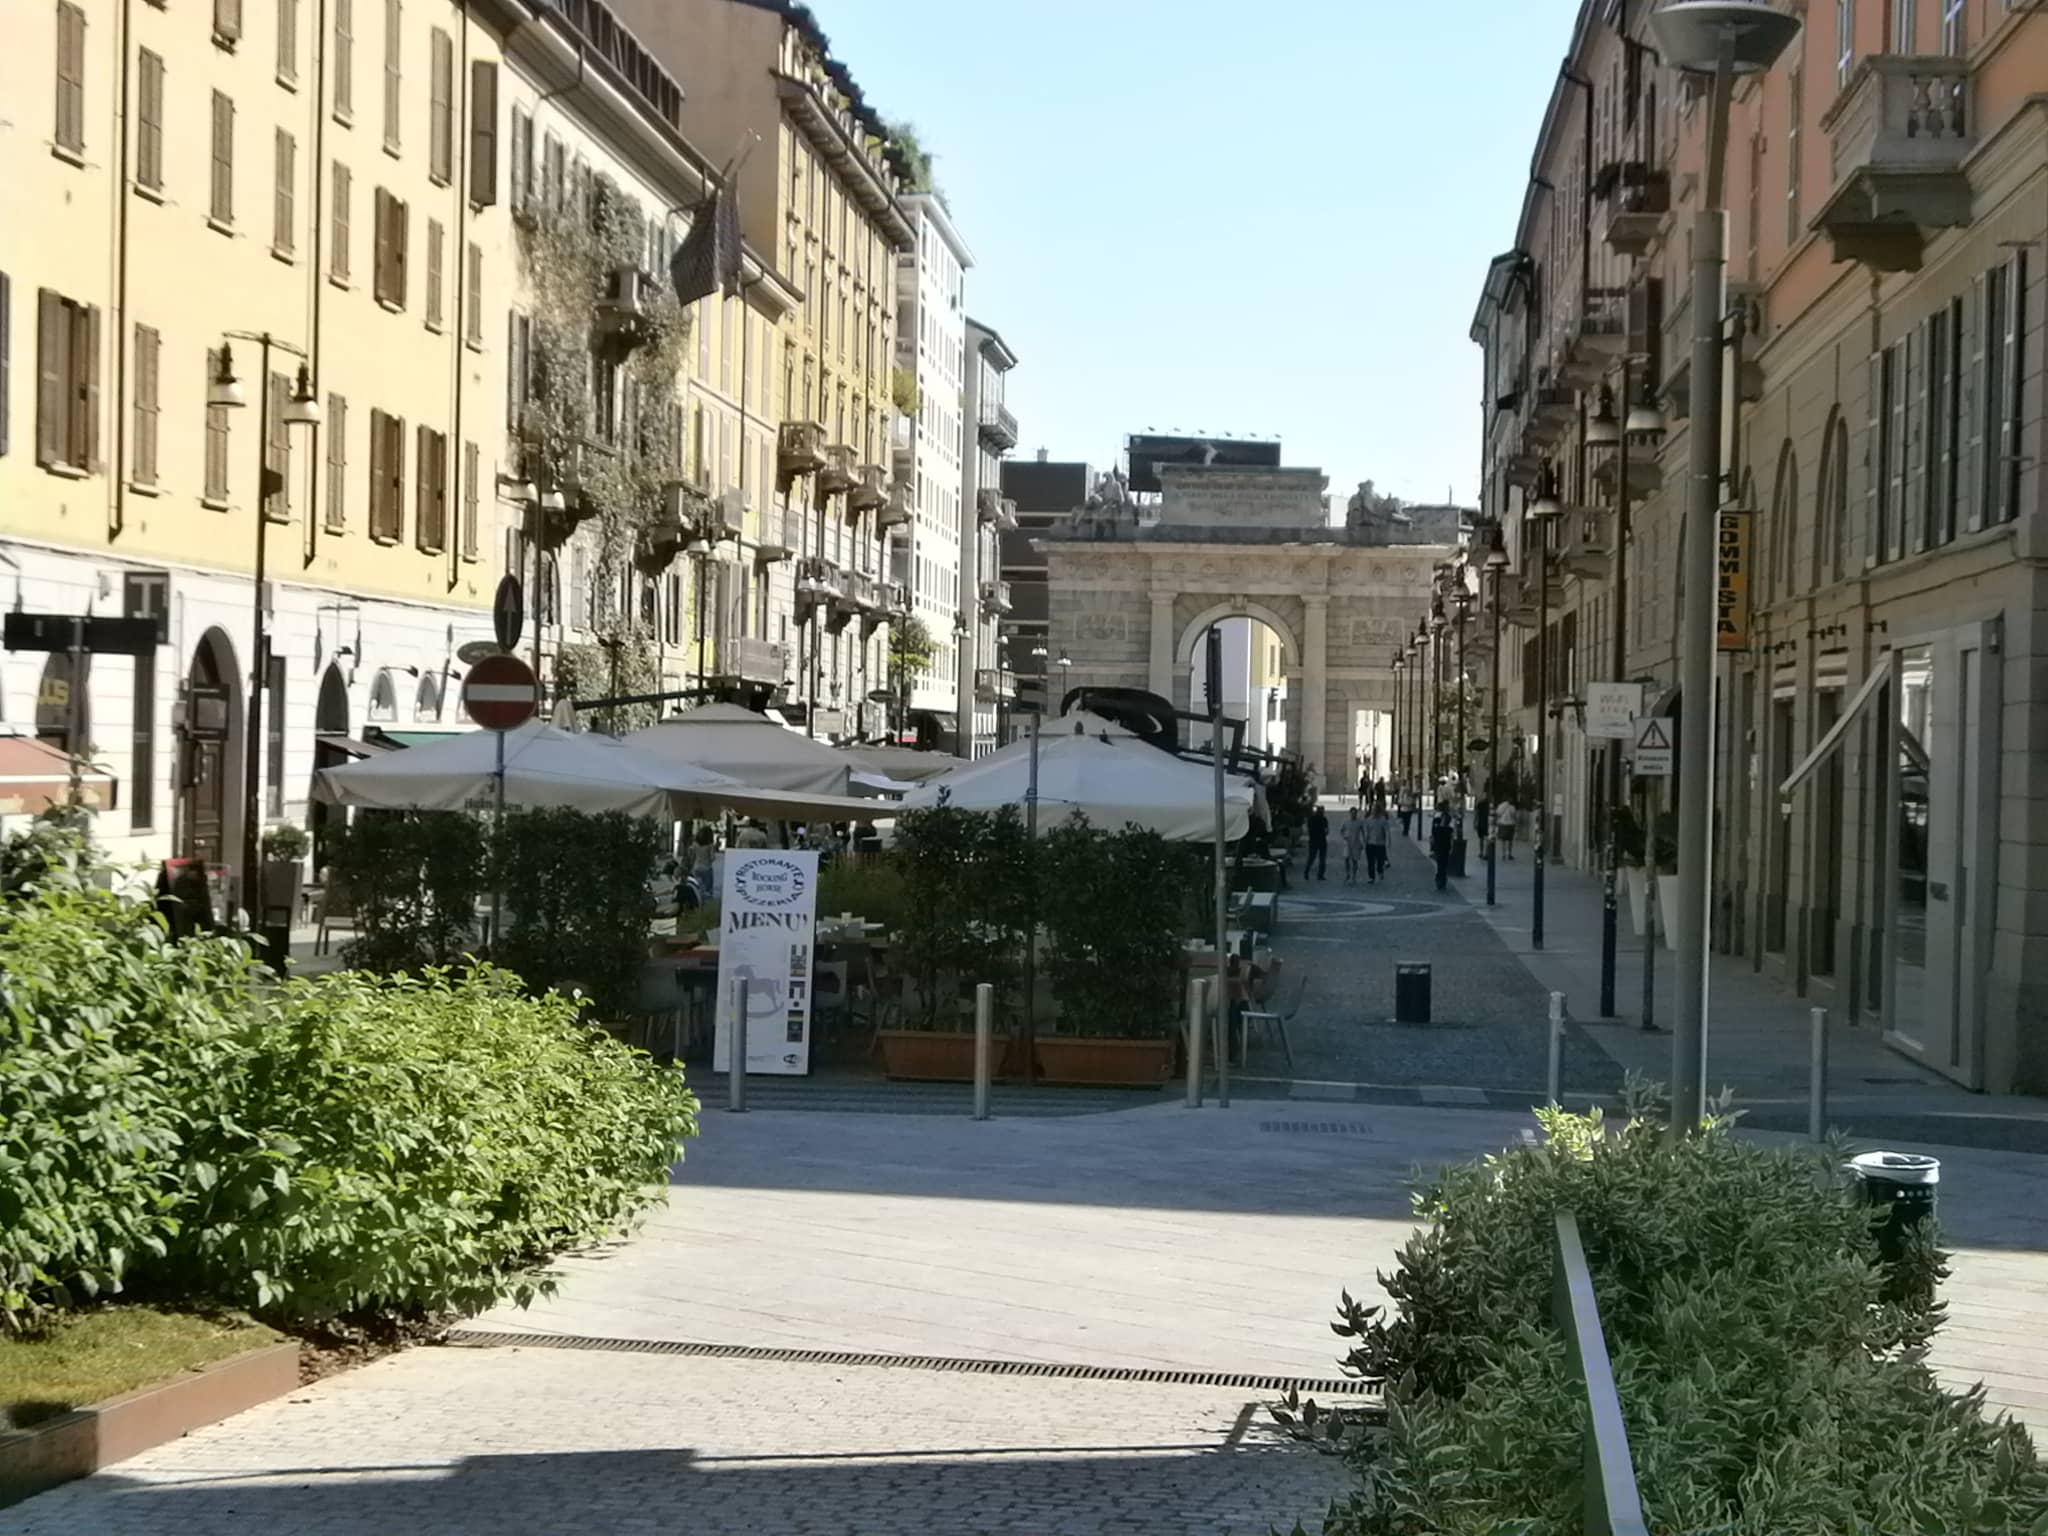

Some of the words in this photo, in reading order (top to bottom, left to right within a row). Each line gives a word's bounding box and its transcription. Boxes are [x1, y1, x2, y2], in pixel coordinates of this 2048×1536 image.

[1717, 516, 1740, 634] GOMMISTA
[735, 858, 805, 879] RISTORANTE
[735, 888, 804, 907] PIZZERIA
